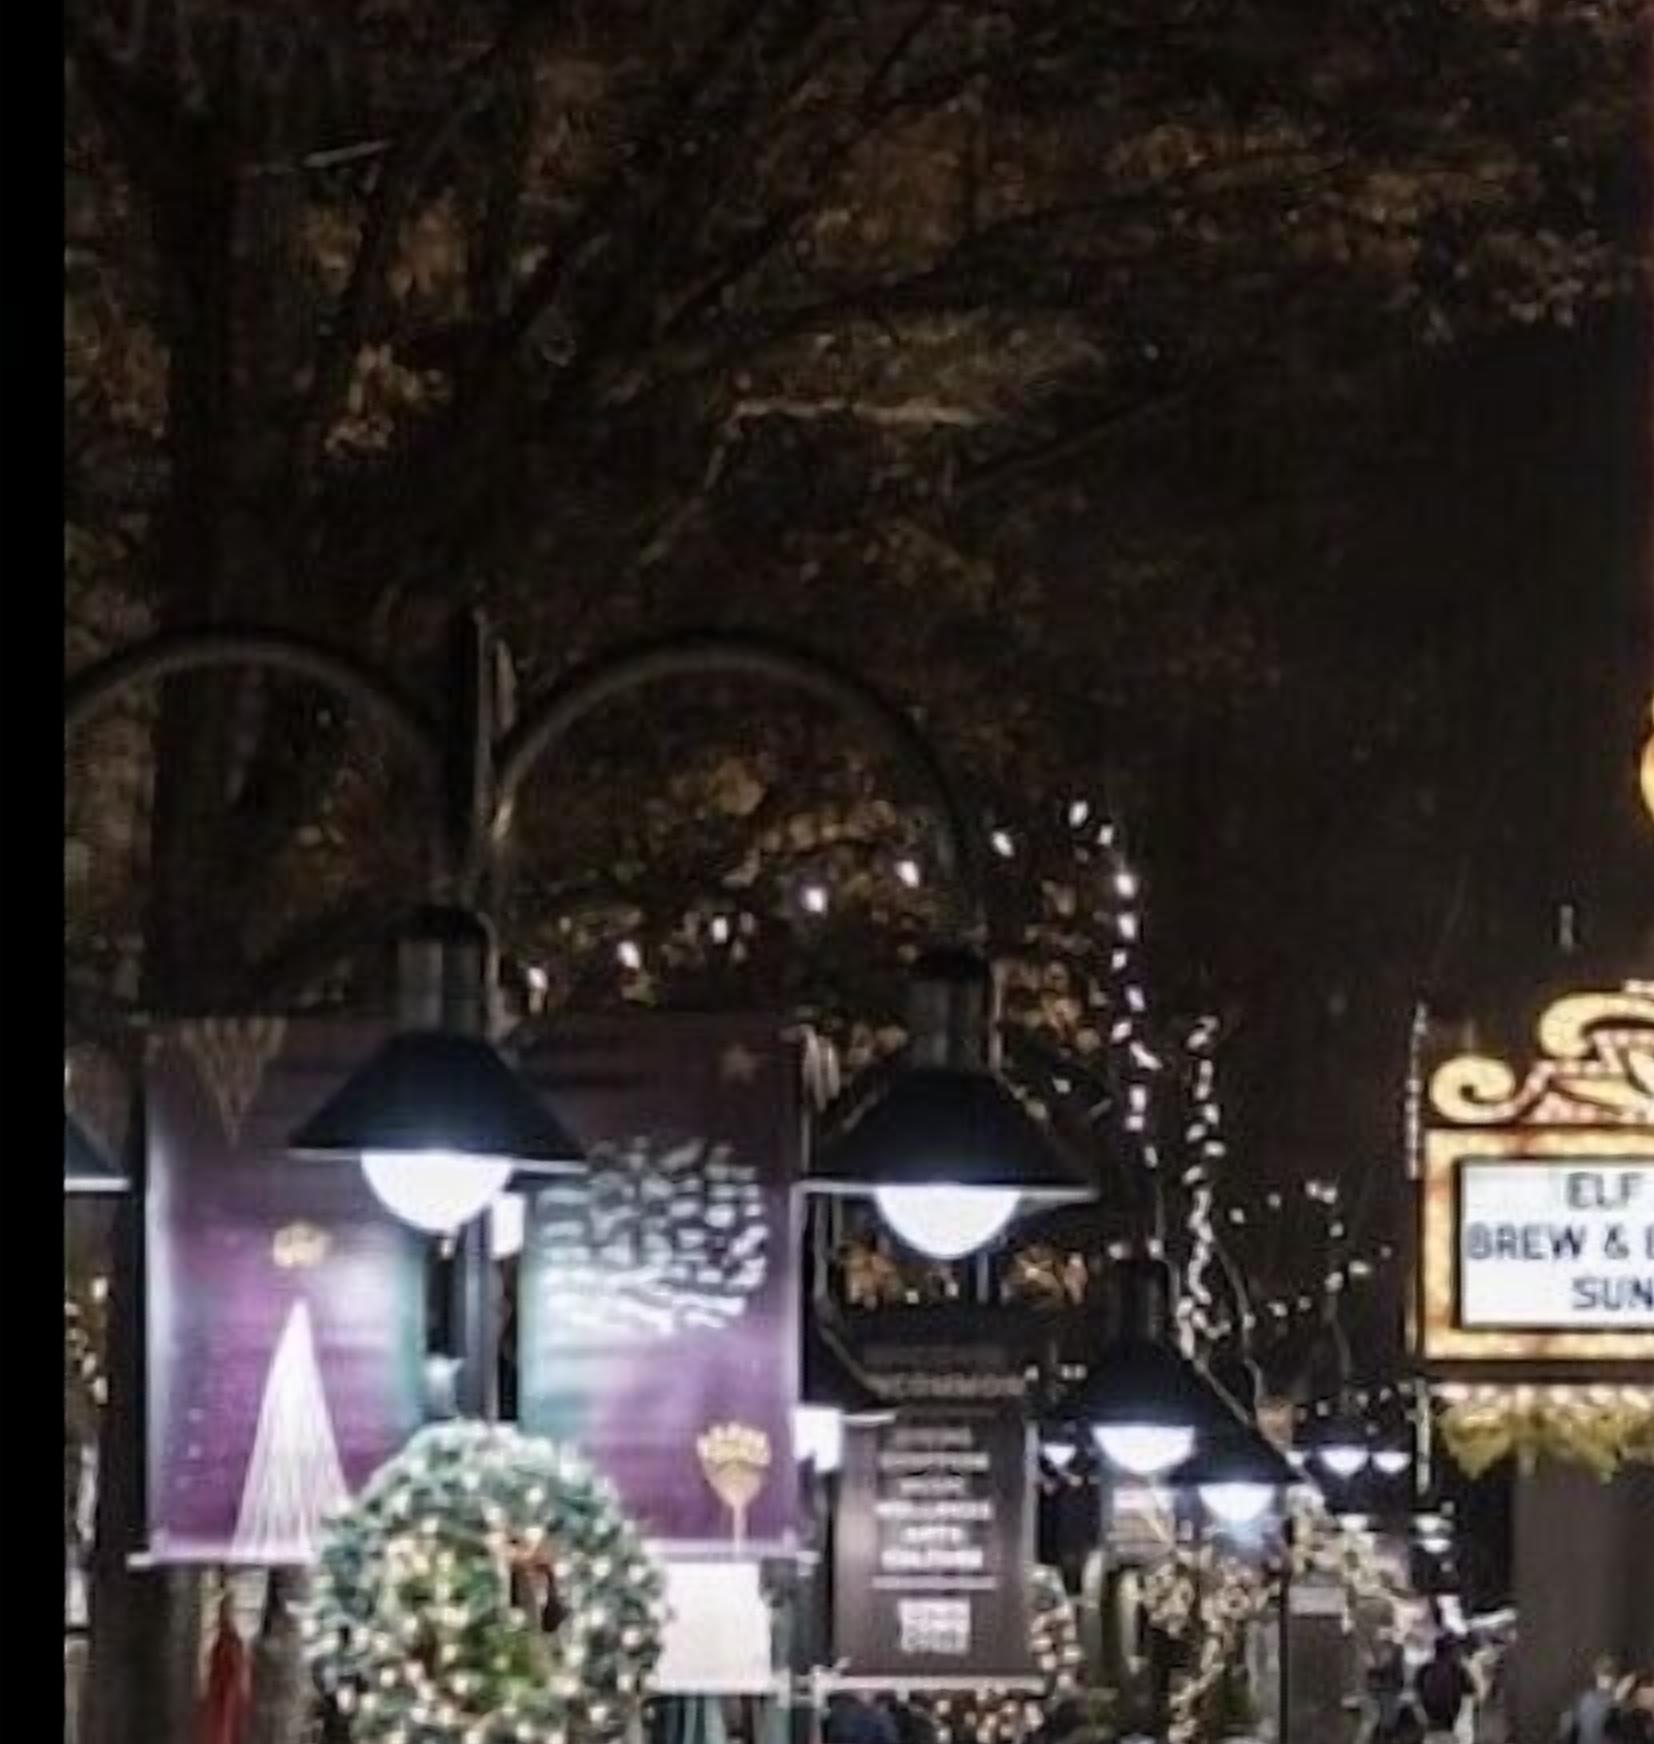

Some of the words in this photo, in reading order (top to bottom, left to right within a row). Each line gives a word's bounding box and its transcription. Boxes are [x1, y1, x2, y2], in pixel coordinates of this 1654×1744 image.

[1566, 1171, 1641, 1209] ELF
[1466, 1222, 1587, 1260] BREW
[1603, 1223, 1630, 1260] &
